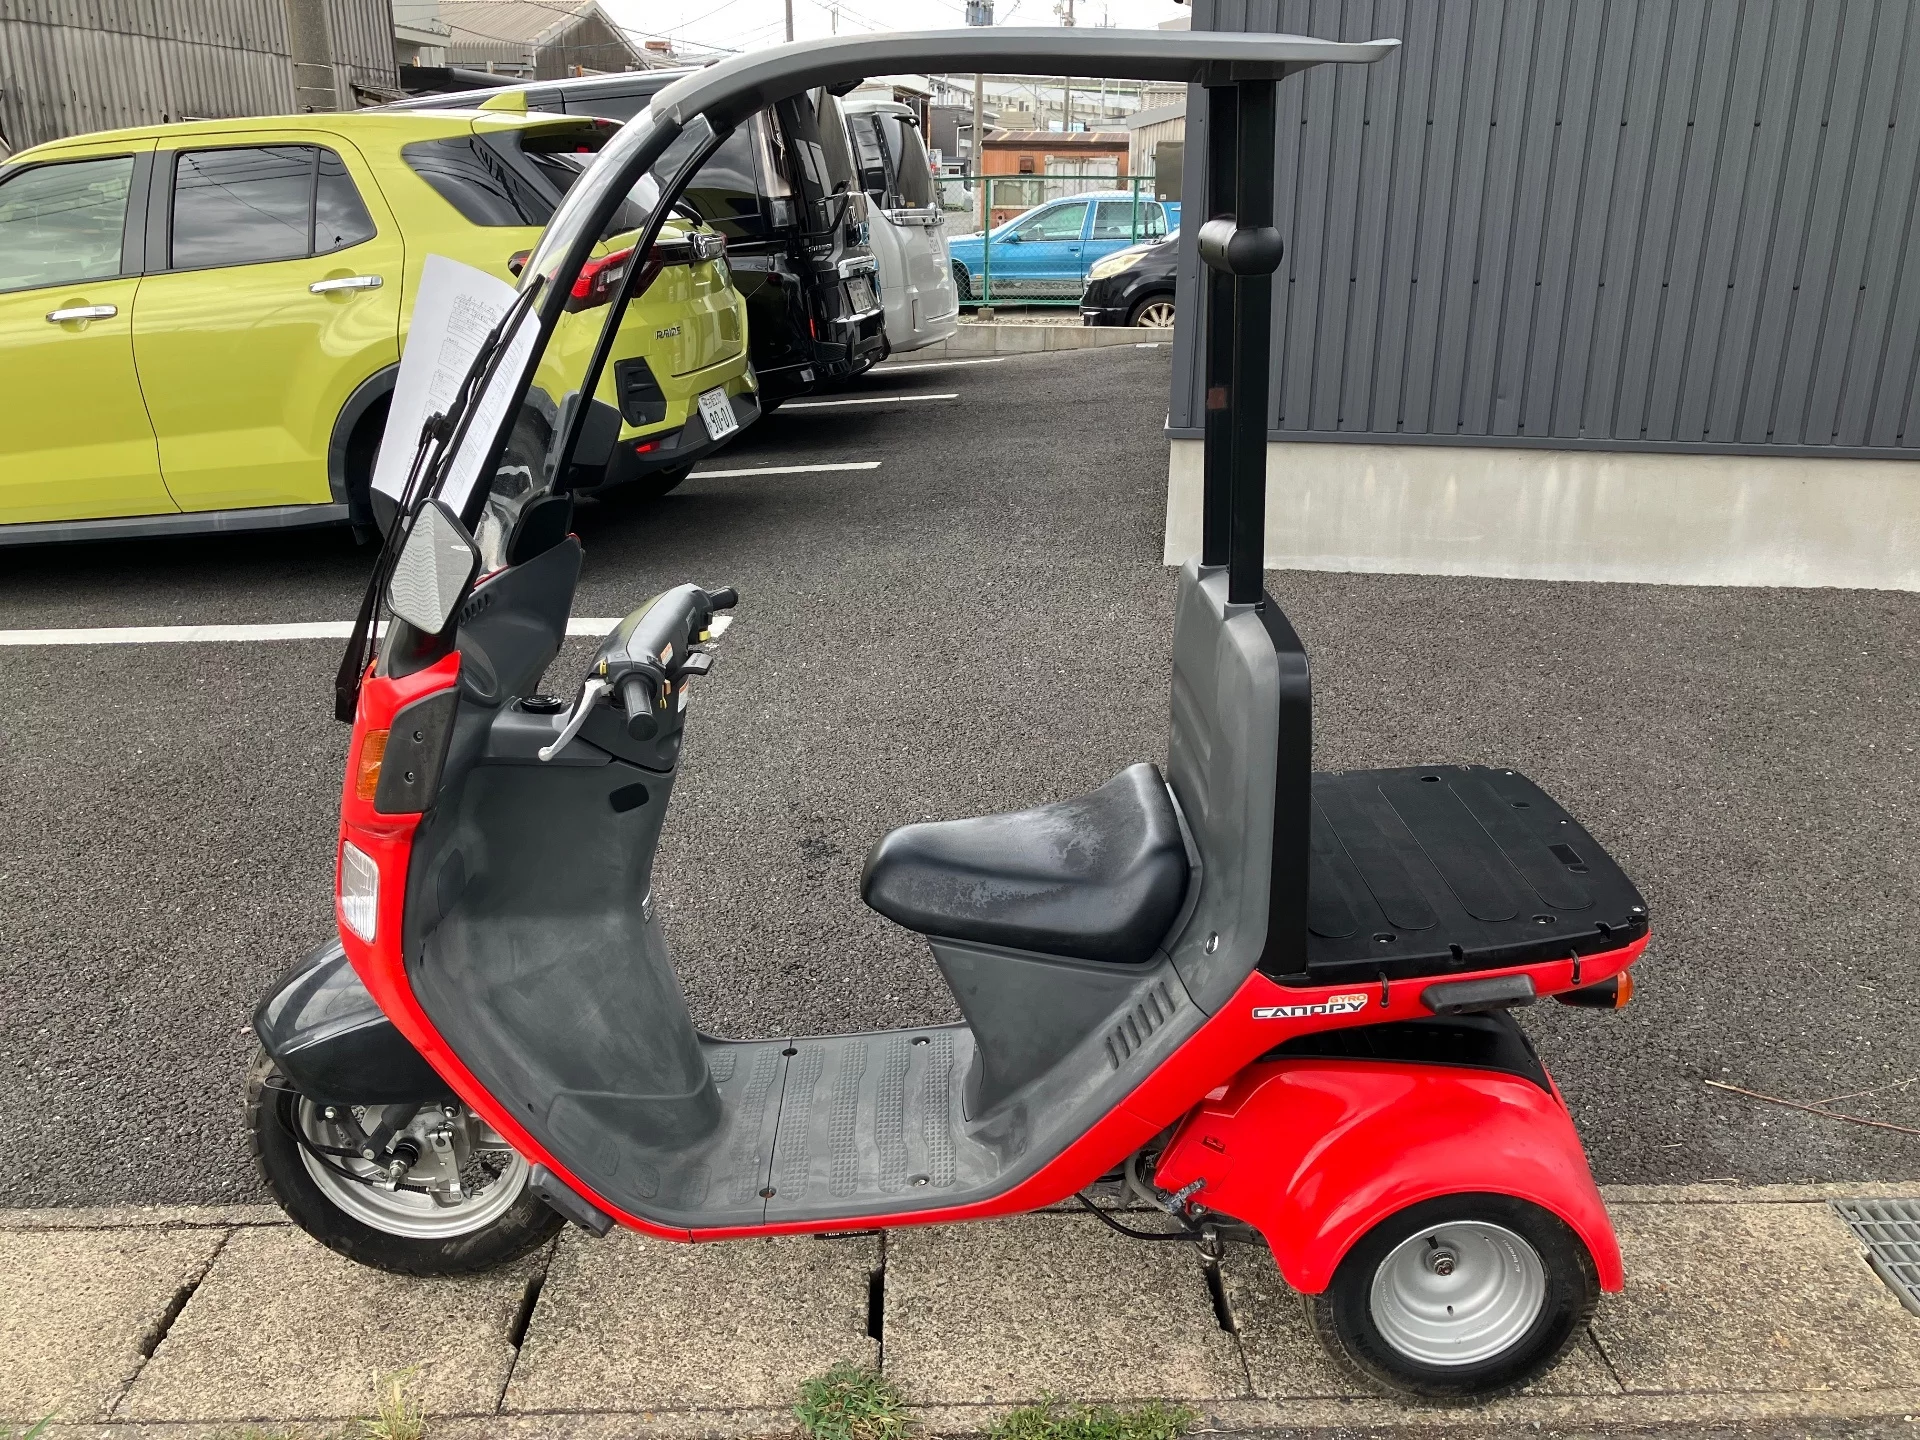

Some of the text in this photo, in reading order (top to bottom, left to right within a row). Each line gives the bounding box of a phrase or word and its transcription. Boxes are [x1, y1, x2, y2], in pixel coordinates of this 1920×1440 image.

[709, 406, 733, 433] 90-01
[1331, 994, 1366, 1003] GYRO
[1254, 1002, 1364, 1018] CANOPY
